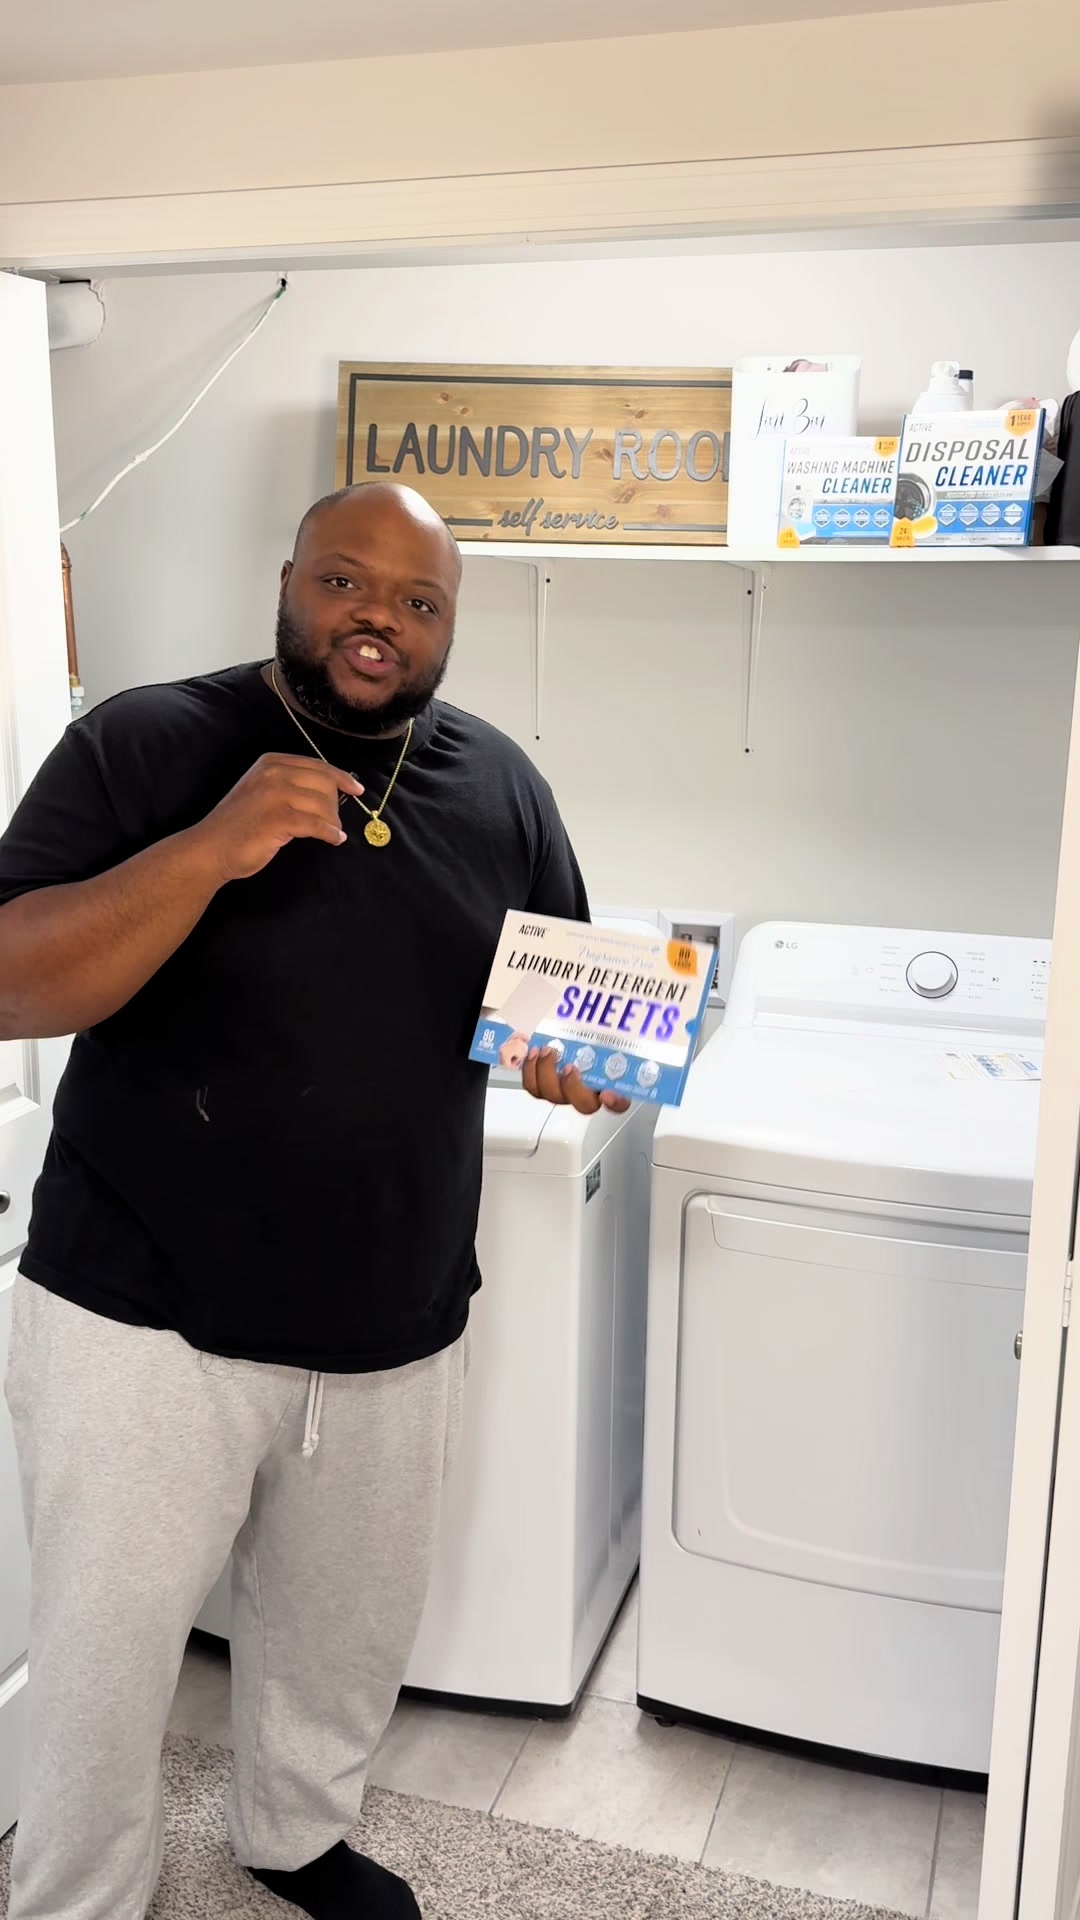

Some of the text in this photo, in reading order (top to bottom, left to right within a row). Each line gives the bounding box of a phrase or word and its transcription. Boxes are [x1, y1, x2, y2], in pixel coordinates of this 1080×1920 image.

[793, 397, 826, 435] Bin
[1009, 415, 1016, 427] 1
[909, 422, 935, 433] ACTIVE
[366, 422, 594, 479] LAUNDRY
[905, 438, 1030, 463] DISPOSAL
[787, 460, 896, 474] WASHING MACHINE
[934, 464, 1028, 487] CLEANER
[821, 477, 892, 494] CLEANER
[497, 497, 619, 536] self service
[518, 923, 547, 938] ACTIVE
[786, 941, 798, 950] LG
[507, 950, 691, 1003] LAUNDRY DETERGENT
[556, 984, 681, 1043] SHEETS
[483, 1028, 496, 1042] 80
